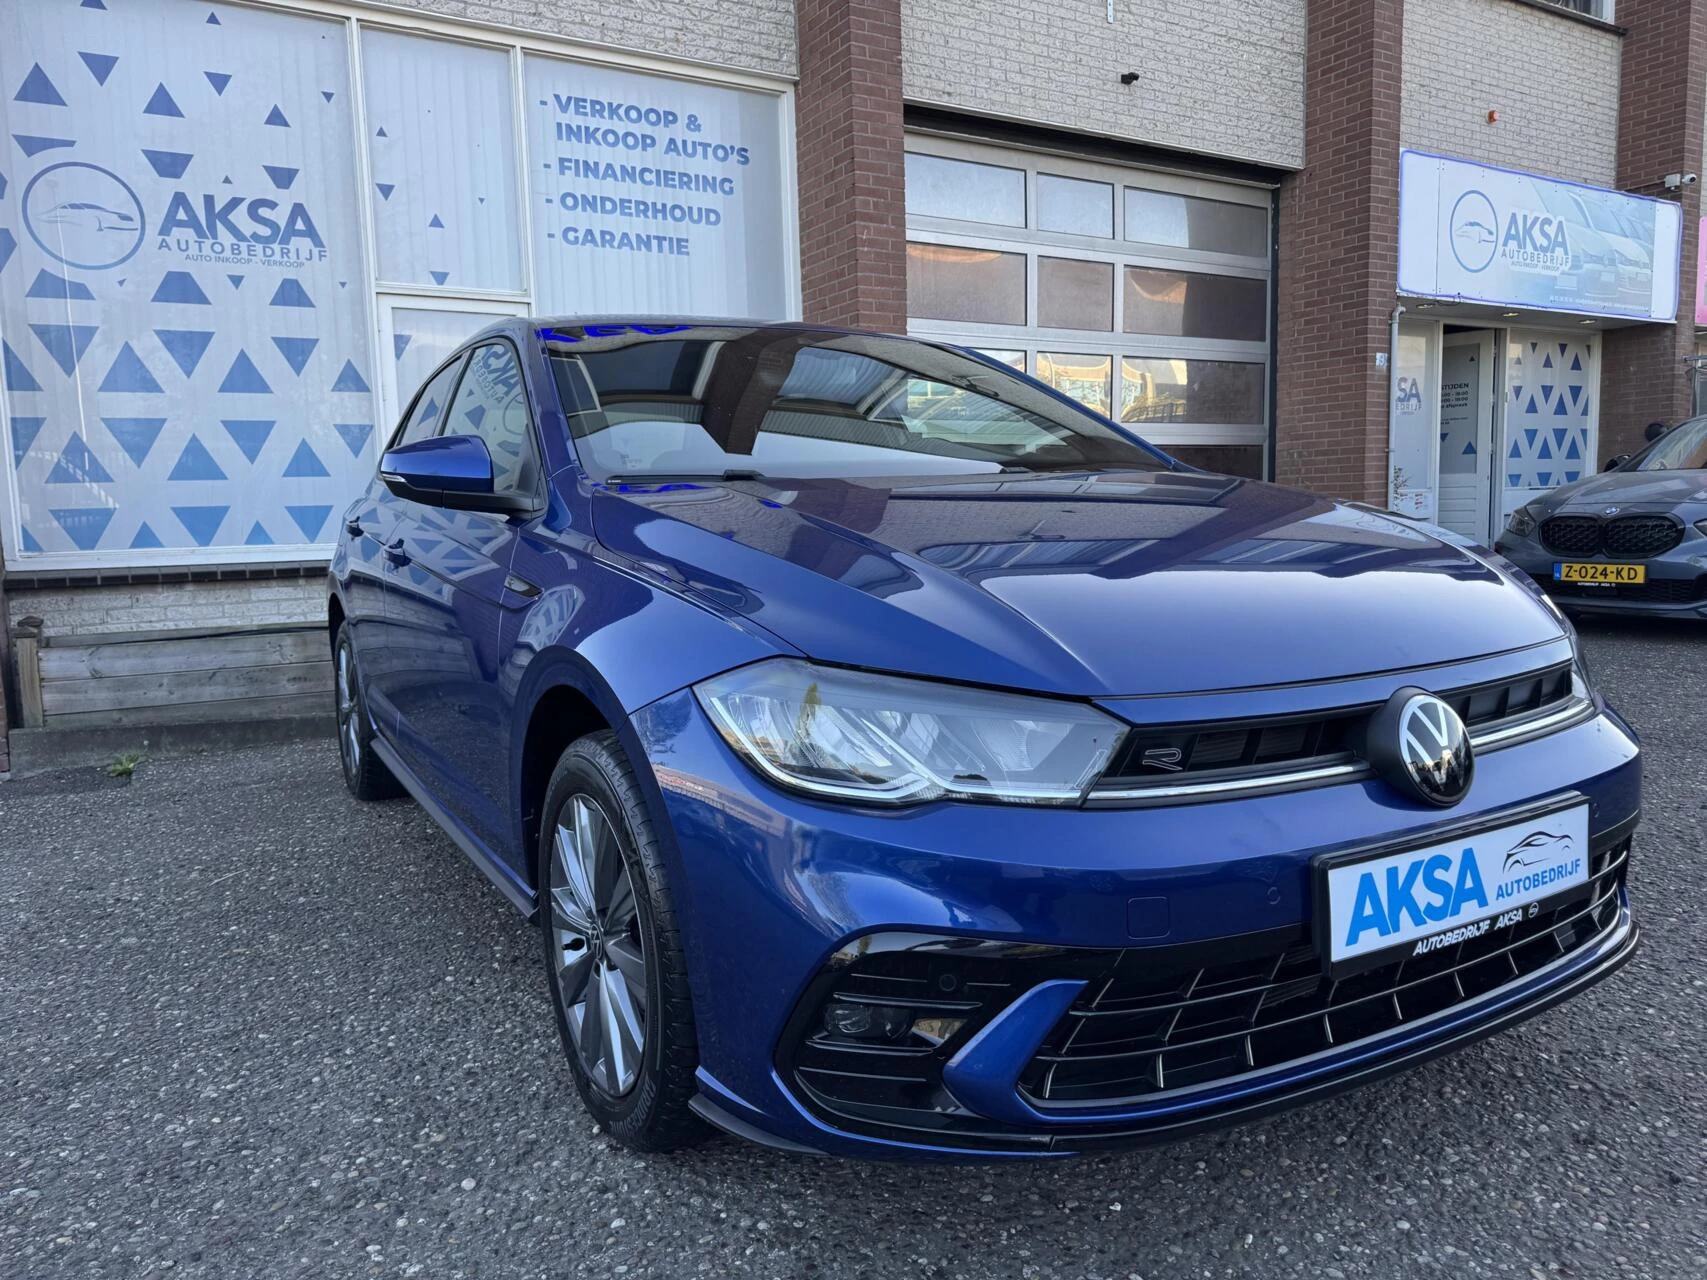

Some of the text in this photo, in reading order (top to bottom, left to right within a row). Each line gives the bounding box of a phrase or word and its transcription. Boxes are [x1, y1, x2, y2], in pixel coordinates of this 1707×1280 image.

[553, 93, 678, 129] VERKOOP
[686, 114, 701, 132] &
[556, 122, 750, 166] INKOOP AUTO'S
[558, 157, 735, 196] FINANCIERING
[157, 191, 326, 249] AKSA
[560, 192, 721, 226] ONDERHOUD
[157, 238, 328, 262] AUTOBEDRIJF
[562, 226, 690, 256] GARANTIE
[1502, 212, 1569, 256] AKSA
[185, 254, 212, 264] AUTO
[214, 255, 253, 266] INKOOP
[261, 259, 305, 269] VERKOOP
[1500, 248, 1570, 267] AUTOBEDRIJF
[1564, 565, 1638, 581] Z-024-KD
[1345, 847, 1488, 946] AKSA
[1496, 858, 1581, 901] AUTOBEDRIJF
[1413, 908, 1523, 956] AUTOBEDRIJF AKSA
